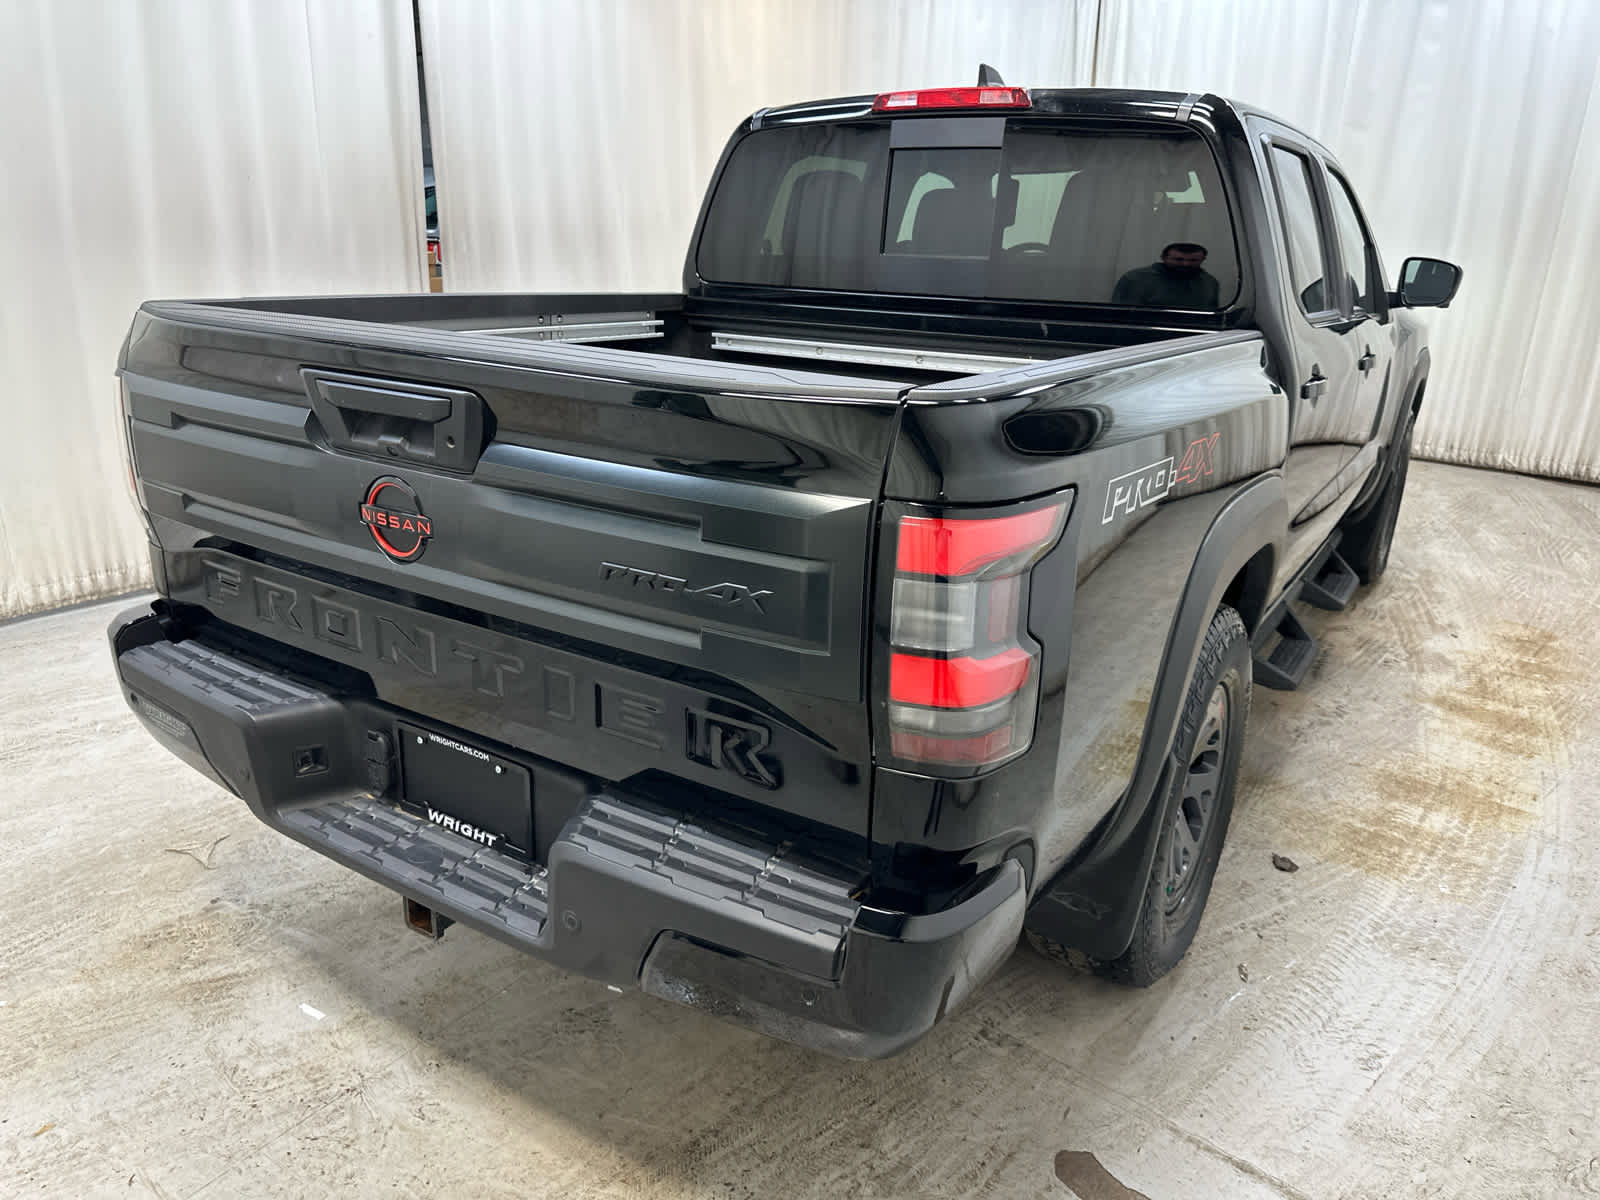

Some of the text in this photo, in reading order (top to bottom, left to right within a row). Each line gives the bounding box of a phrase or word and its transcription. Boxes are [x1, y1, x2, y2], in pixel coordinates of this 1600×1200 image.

[361, 506, 431, 535] NISSAN
[600, 561, 775, 616] PRO-4X
[202, 558, 782, 790] FRONTIER
[428, 733, 490, 762] WRIGHTCARS.COM
[427, 807, 497, 847] WRIGHT
